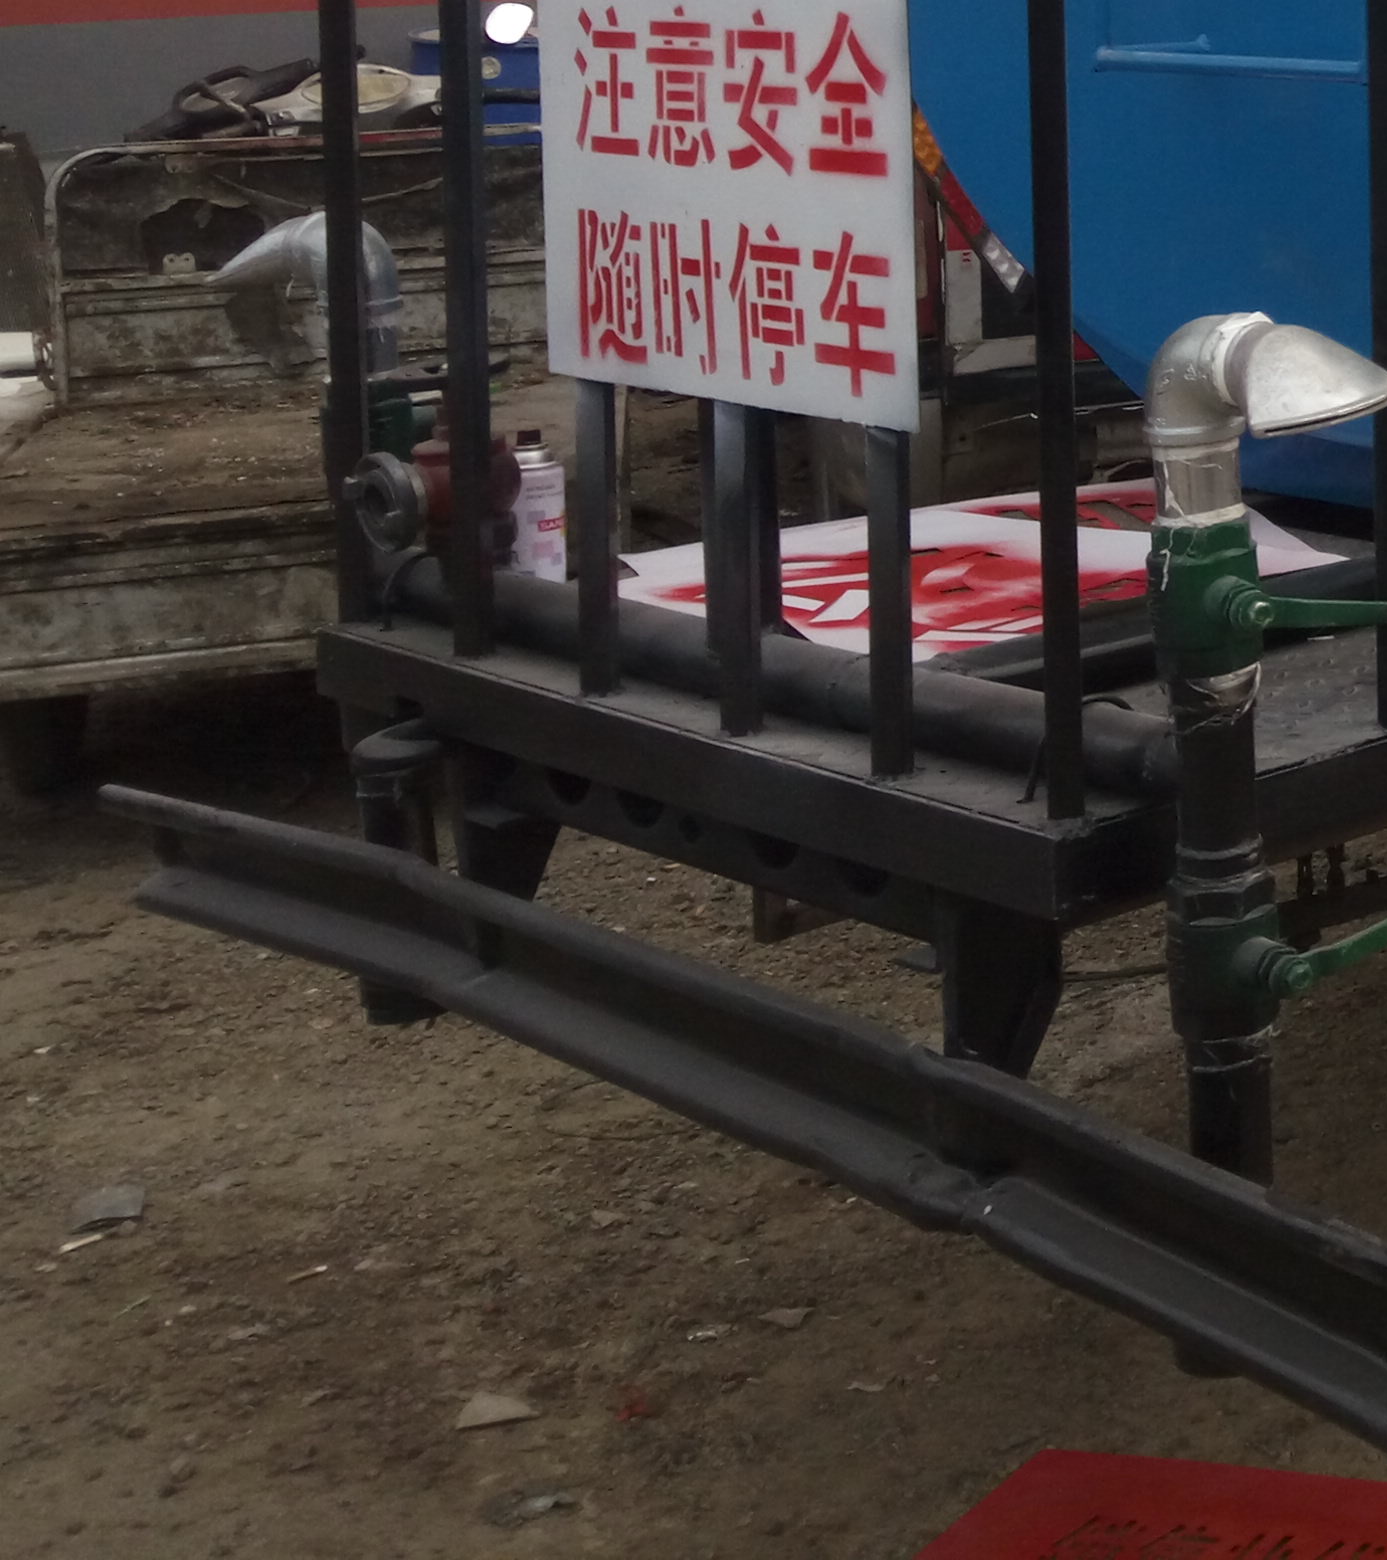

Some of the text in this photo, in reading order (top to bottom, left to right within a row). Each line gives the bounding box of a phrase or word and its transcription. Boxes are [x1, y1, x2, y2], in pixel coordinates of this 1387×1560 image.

[575, 5, 889, 178] 注意安全
[578, 208, 896, 398] 随时停车
